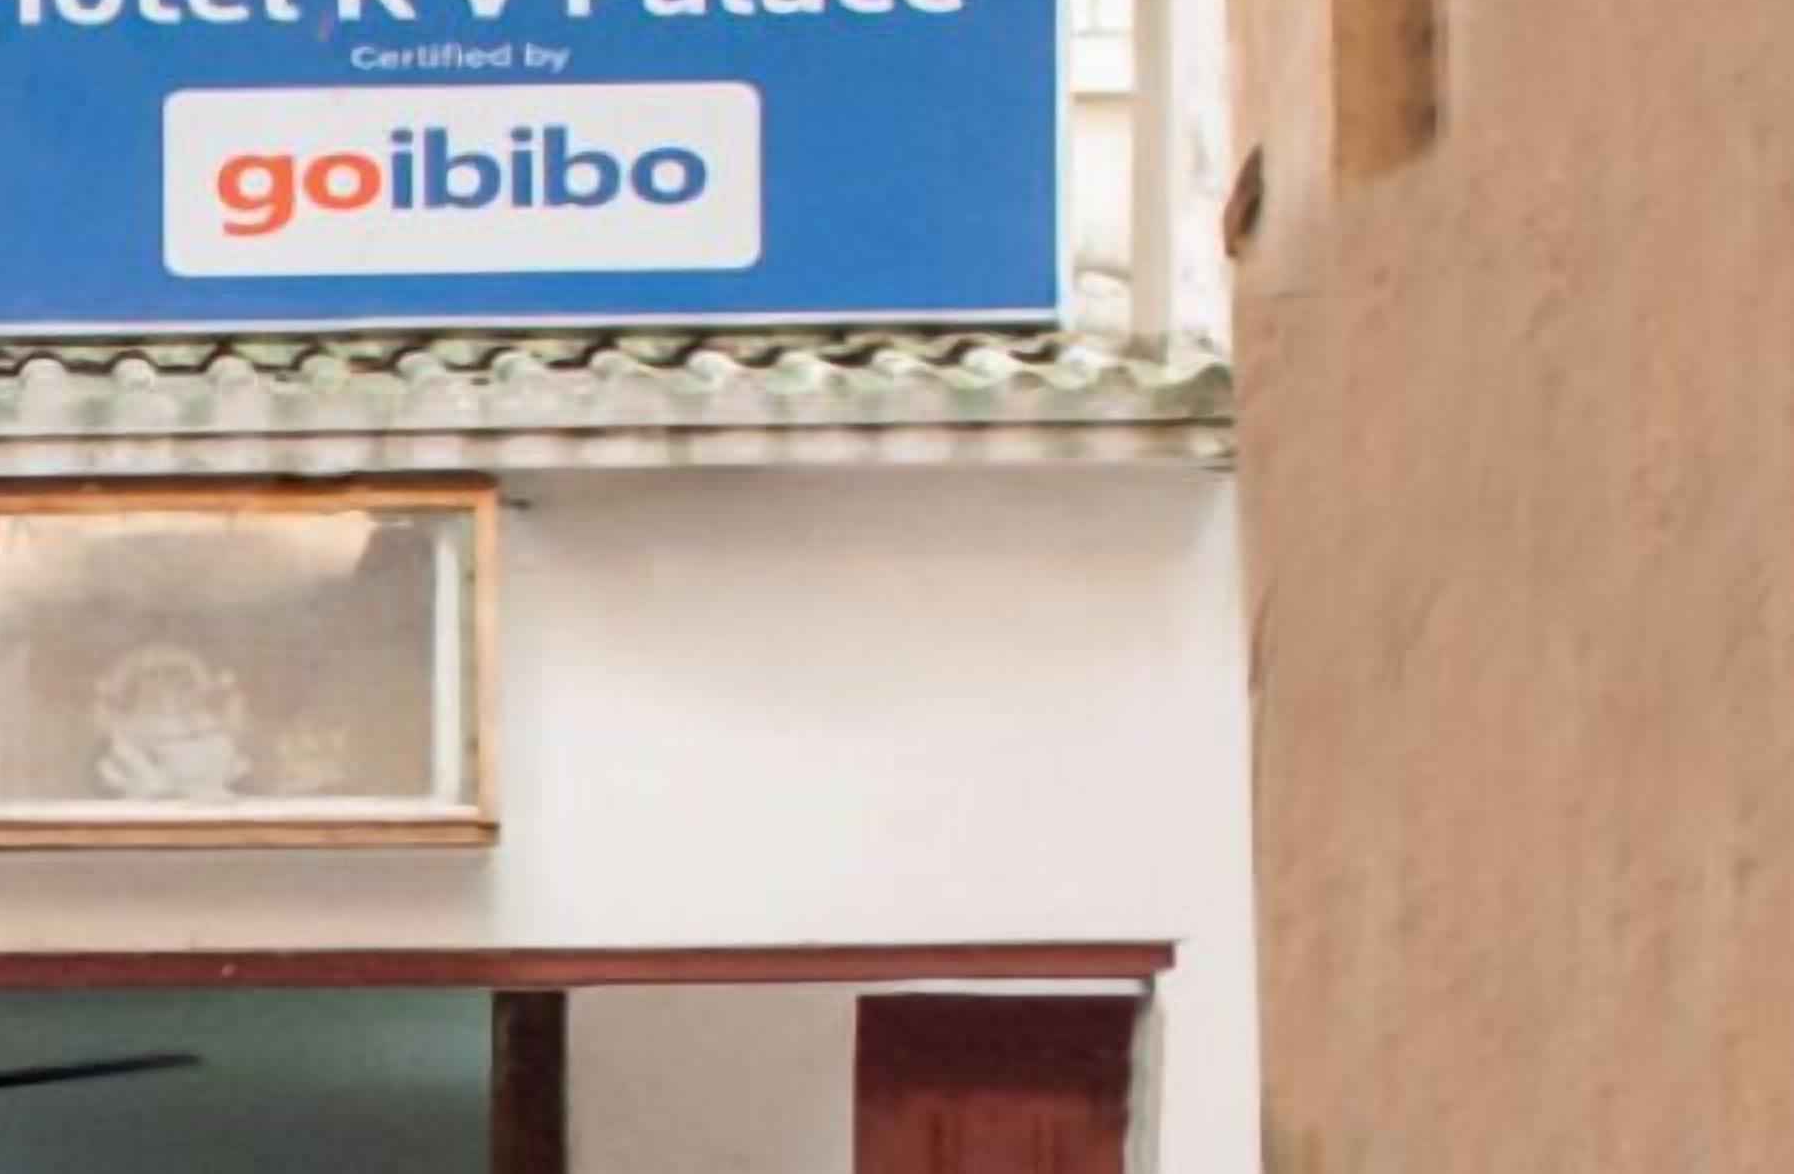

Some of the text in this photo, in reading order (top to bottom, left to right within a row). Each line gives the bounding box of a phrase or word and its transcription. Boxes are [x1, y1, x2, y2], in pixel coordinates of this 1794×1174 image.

[349, 40, 571, 74] Certified by
[216, 125, 709, 238] goibibo
